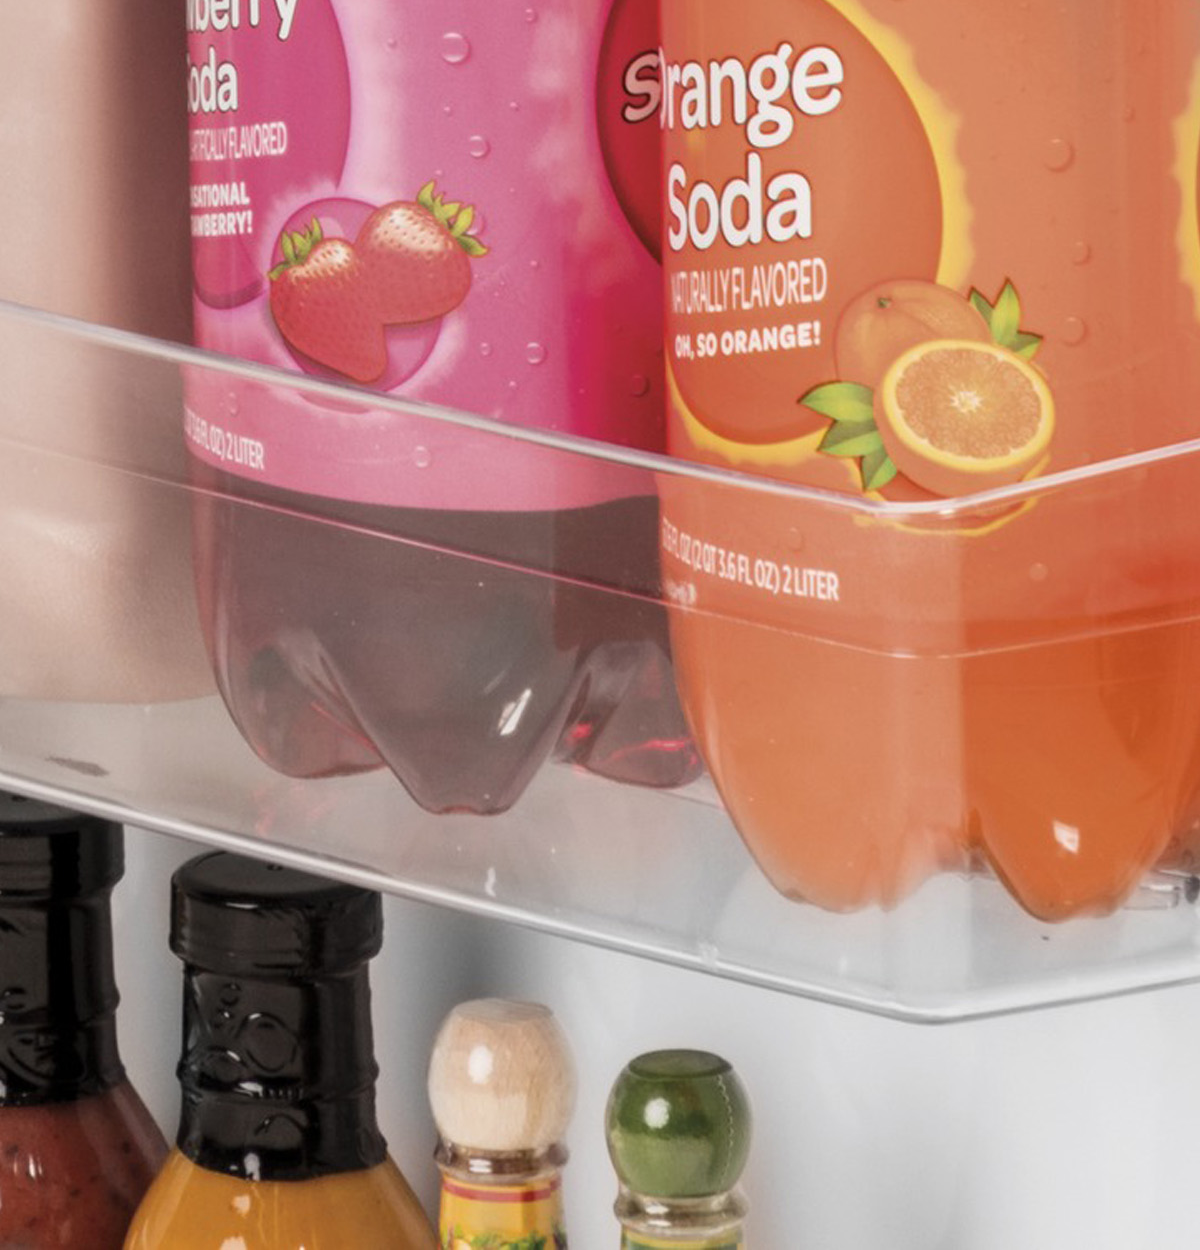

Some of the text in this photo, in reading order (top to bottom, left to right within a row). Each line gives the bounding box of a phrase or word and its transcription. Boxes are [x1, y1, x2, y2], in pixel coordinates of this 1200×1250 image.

[229, 121, 288, 160] FLAVORED
[667, 152, 812, 251] Soda
[731, 257, 828, 310] FLAVORED
[675, 320, 822, 361] OH, SO ORANGE!
[226, 431, 233, 461] 2
[233, 434, 265, 471] LITER
[703, 543, 717, 576] QT
[718, 551, 736, 582] 3.6
[737, 554, 754, 586] FL
[754, 558, 781, 595] OZ)
[782, 566, 792, 595] 2
[794, 567, 840, 601] LITER
